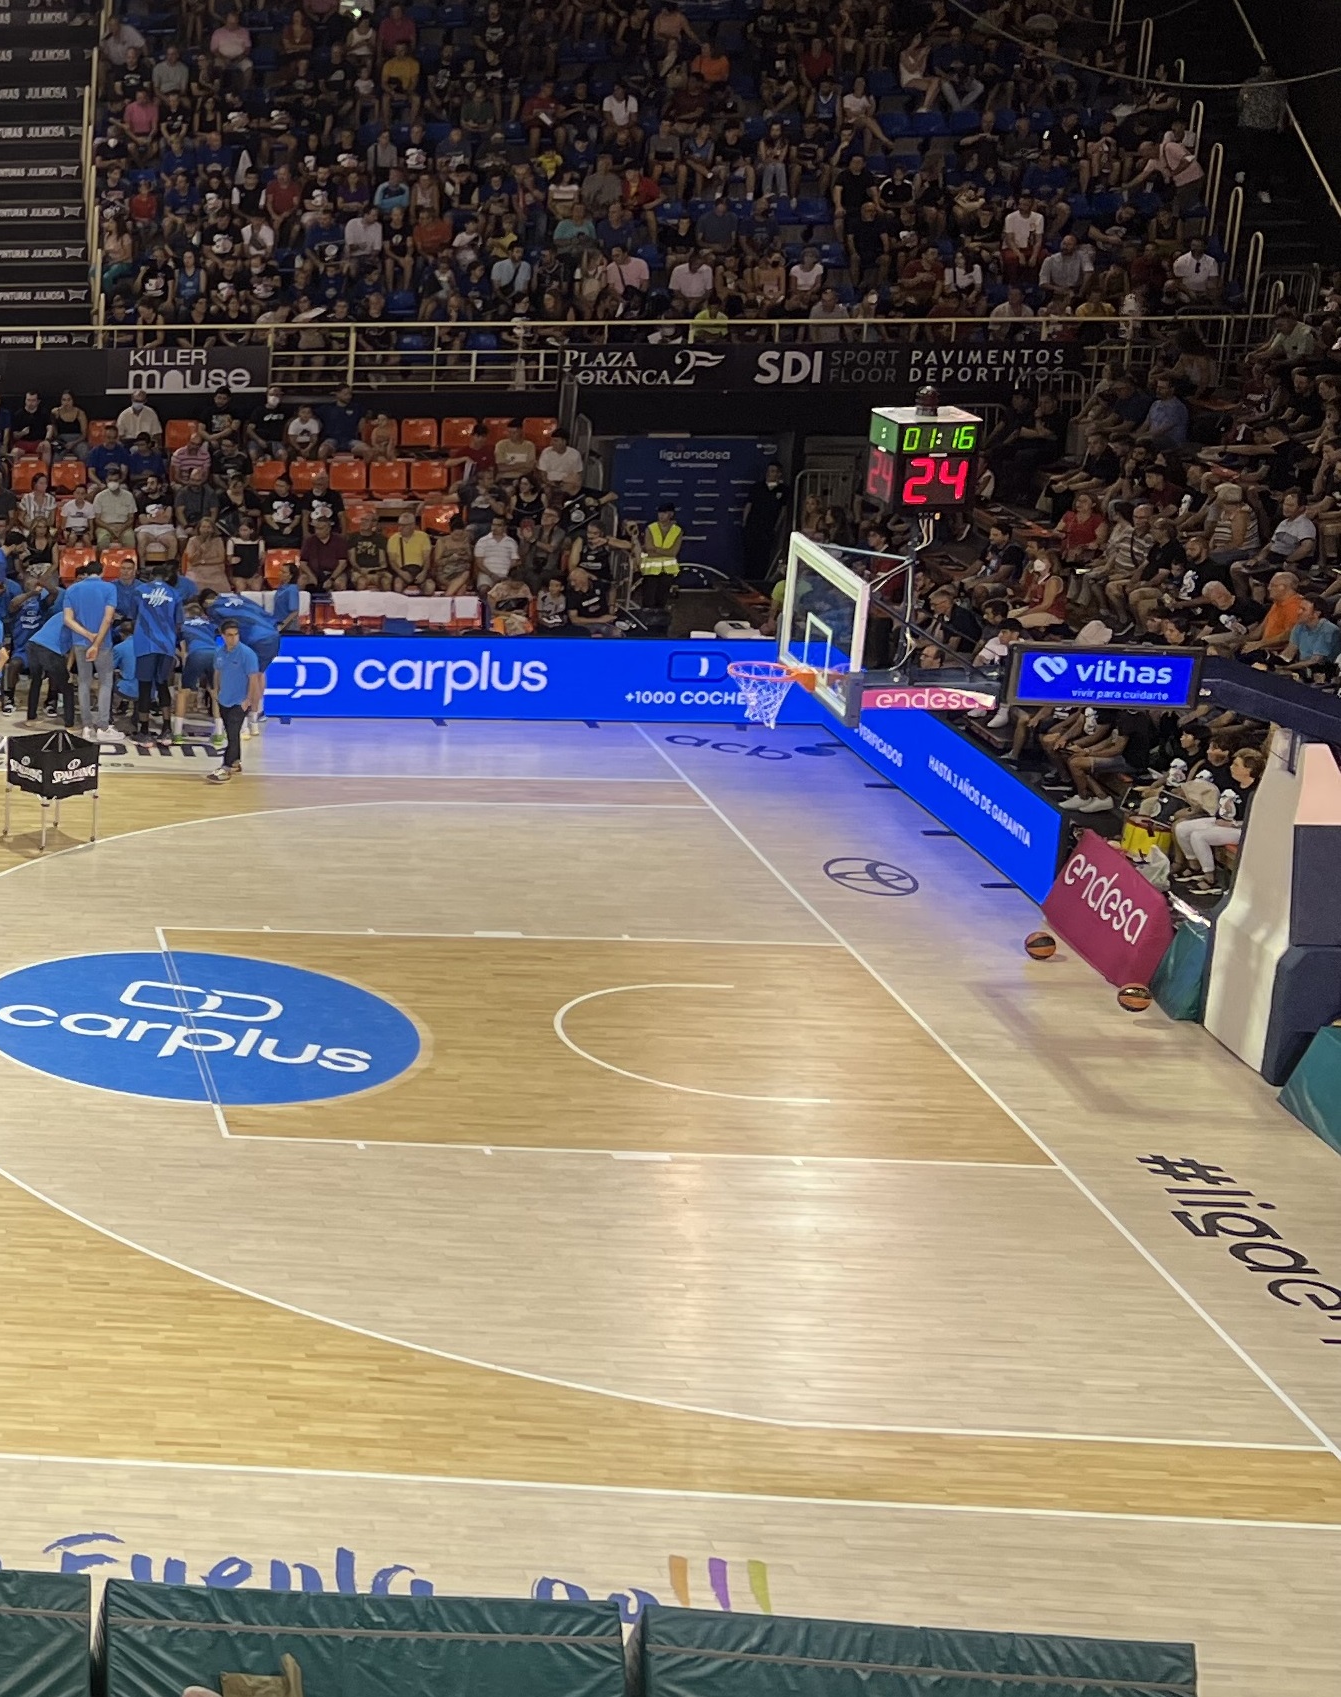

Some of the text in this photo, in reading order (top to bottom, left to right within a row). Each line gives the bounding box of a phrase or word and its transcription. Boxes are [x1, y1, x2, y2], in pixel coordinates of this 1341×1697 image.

[27, 12, 68, 24] JULMOSA
[29, 49, 70, 61] JULMOSA
[25, 87, 67, 99] JULMOSA
[27, 126, 65, 137] JULMOSA
[27, 167, 58, 176] JULMOSA
[129, 349, 207, 366] KILLER
[564, 350, 637, 367] PLAZA
[830, 349, 1064, 366] SPORT PAVIMENTOS
[754, 351, 822, 385] SDI
[829, 367, 896, 383] FLOOR
[128, 367, 251, 390] mouse
[903, 426, 976, 451] 01:16
[903, 457, 969, 505] 24
[354, 651, 548, 705] carplus
[1076, 660, 1172, 684] vithas
[625, 690, 676, 705] +1000
[1071, 688, 1169, 701] vivir para cuidarte
[665, 735, 793, 760] acb
[859, 722, 903, 767] VERIFICADOS
[52, 764, 97, 784] SPALDING
[928, 754, 953, 784] HASTA
[958, 778, 980, 806] AÑOS
[980, 794, 991, 815] DE
[991, 804, 1031, 848] GARANTIA
[1064, 852, 1149, 945] endesa
